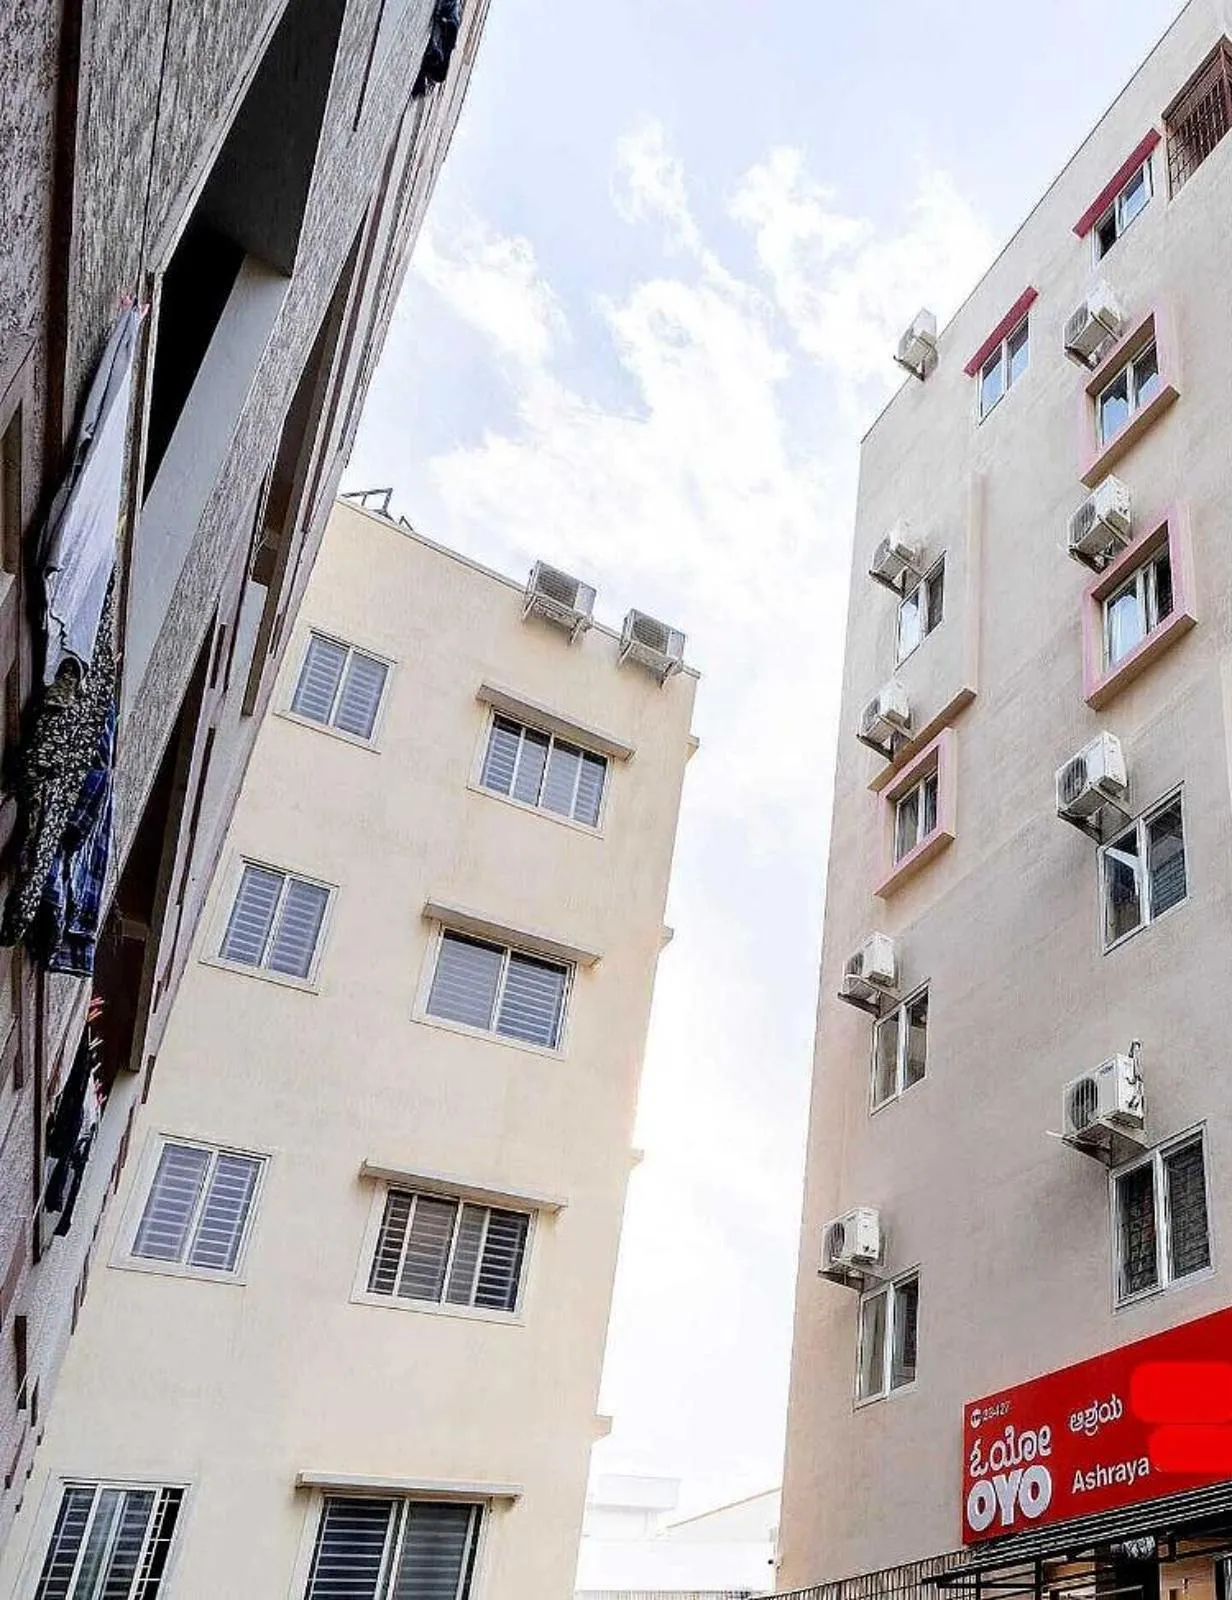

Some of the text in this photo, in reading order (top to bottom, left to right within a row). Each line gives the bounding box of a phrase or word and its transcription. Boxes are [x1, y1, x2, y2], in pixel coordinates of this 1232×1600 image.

[1070, 1393, 1123, 1437] ಆಶ್ರಯ
[969, 1424, 1052, 1478] ಓಯೋ
[1071, 1456, 1150, 1494] Ashraya
[967, 1465, 1052, 1531] OYO
